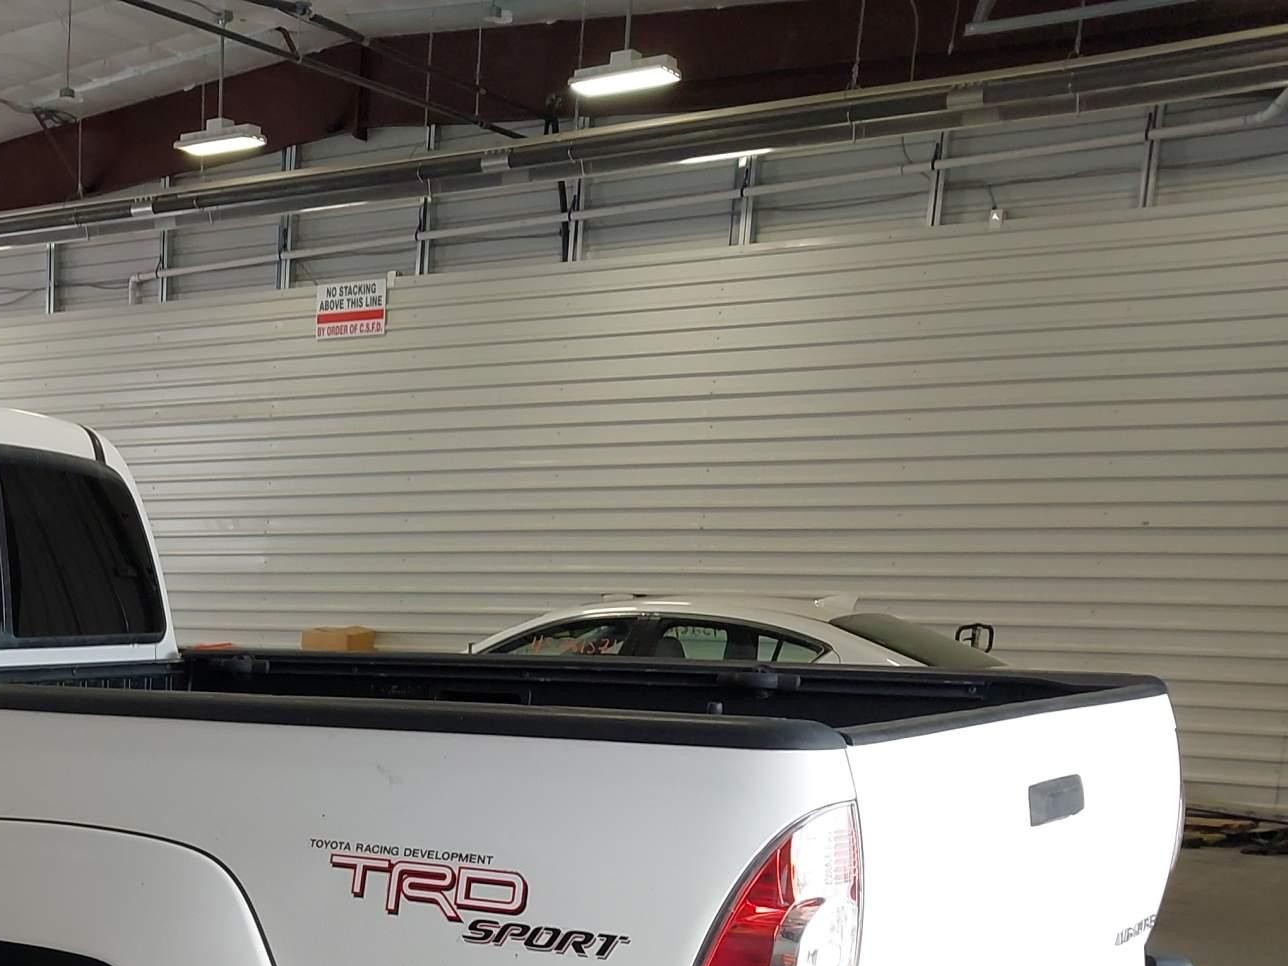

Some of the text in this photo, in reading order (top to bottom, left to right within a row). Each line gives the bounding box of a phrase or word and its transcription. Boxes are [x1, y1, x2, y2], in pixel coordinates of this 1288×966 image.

[326, 283, 377, 298] NO STACKING
[319, 295, 383, 312] ABOVE THIS LINE
[317, 322, 383, 337] BY ORDER OF C.S.F.D.
[310, 838, 494, 865] TOYOTA RACING DEVELOPMENT
[330, 853, 529, 924] TRD
[462, 918, 631, 961] SPORT
